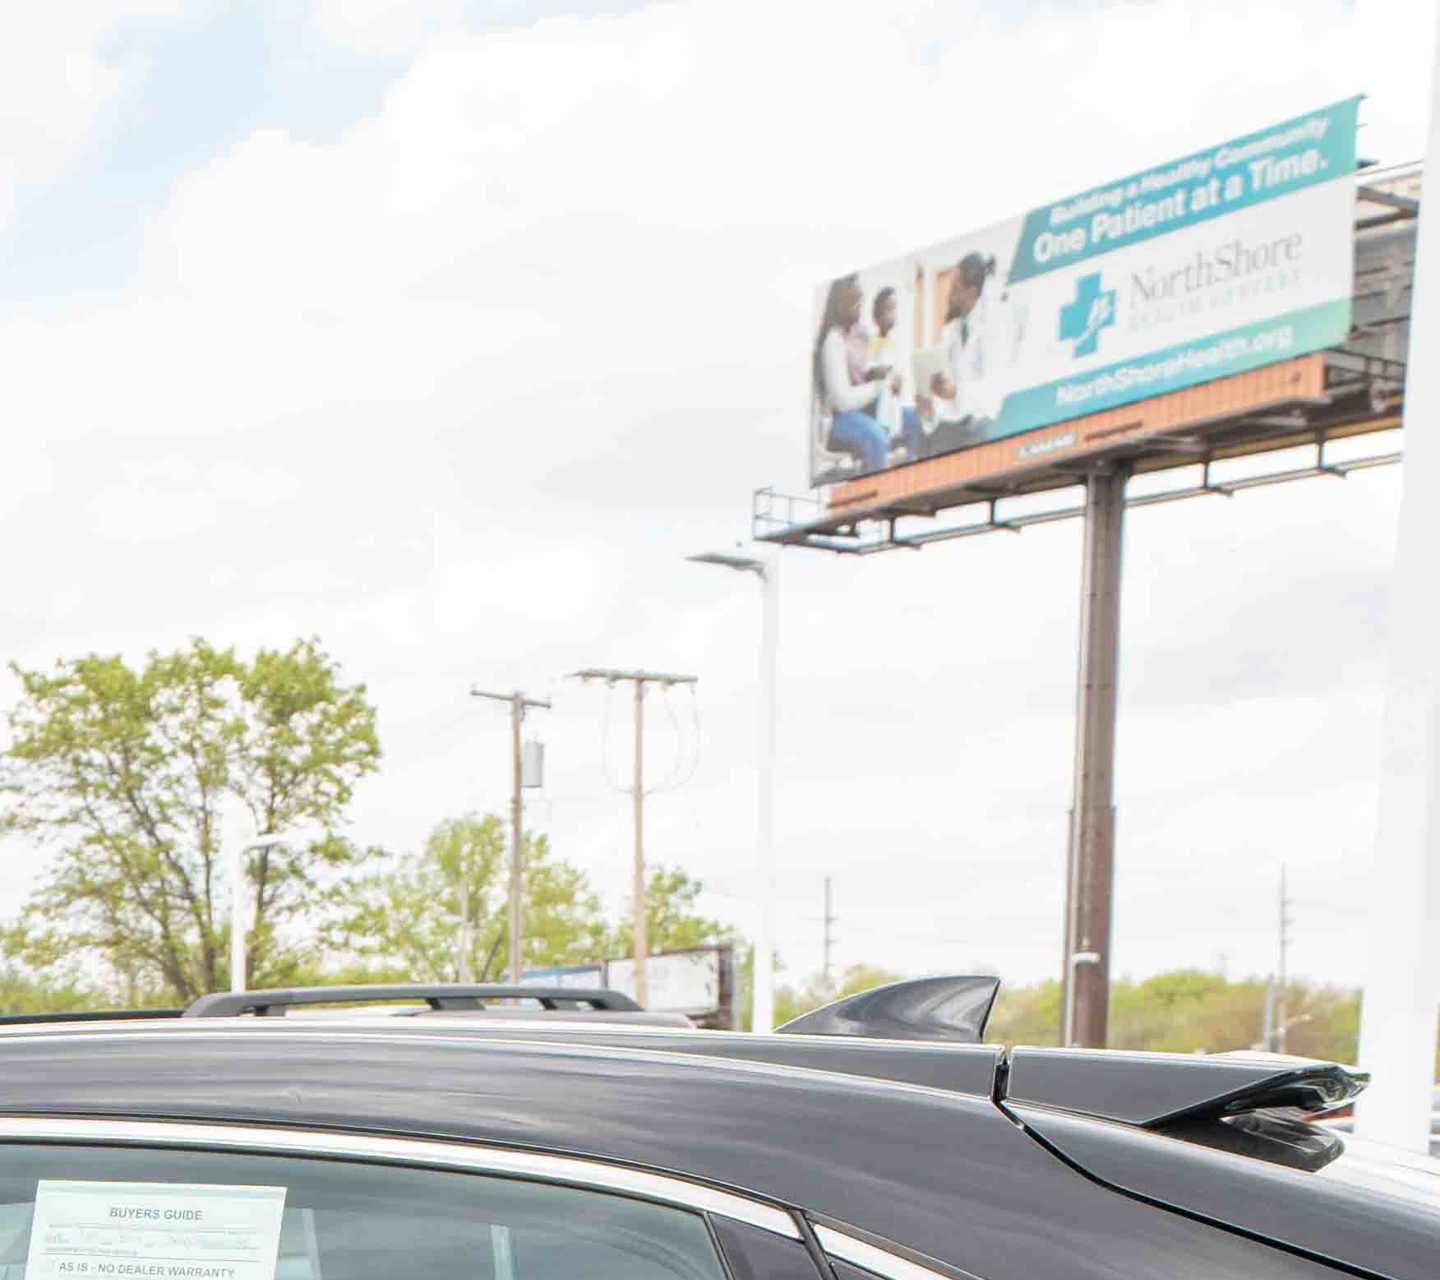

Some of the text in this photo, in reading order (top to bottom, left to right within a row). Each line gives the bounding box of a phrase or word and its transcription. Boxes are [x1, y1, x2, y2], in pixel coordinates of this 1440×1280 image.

[1034, 149, 1328, 263] One Patient at a Time.
[1130, 234, 1302, 300] NorthShore
[109, 1207, 203, 1221] BUYERS GUIDE
[59, 1262, 74, 1272] AS
[77, 1262, 89, 1272] IS
[98, 1263, 115, 1274] NO
[117, 1264, 164, 1277] DEALER
[166, 1265, 236, 1278] WARRANTY
